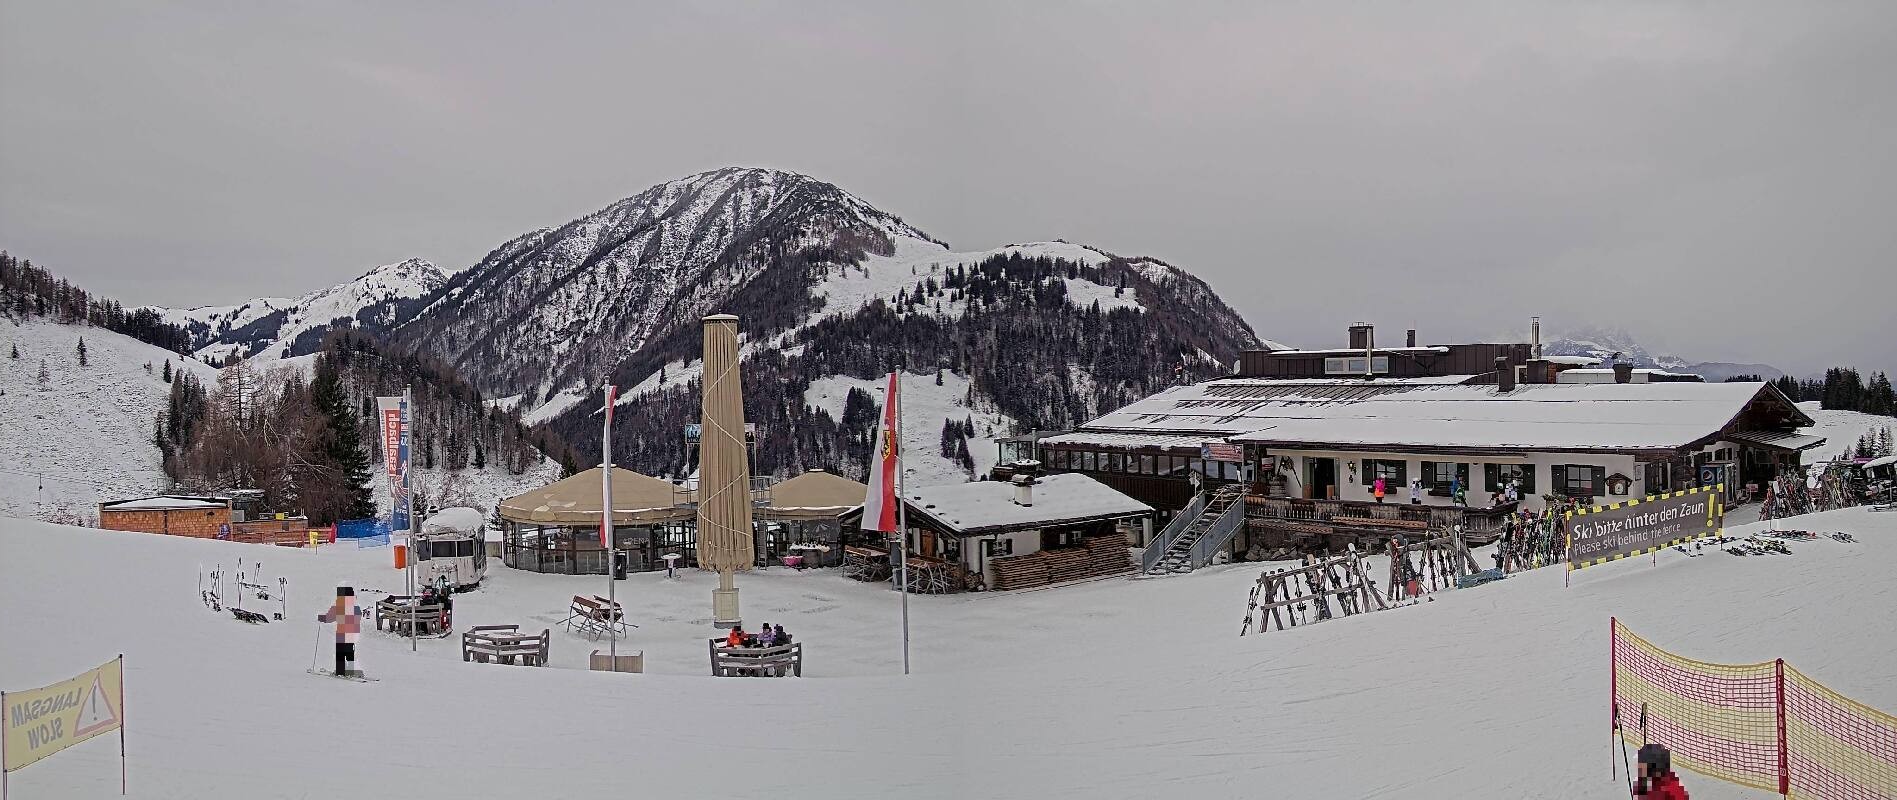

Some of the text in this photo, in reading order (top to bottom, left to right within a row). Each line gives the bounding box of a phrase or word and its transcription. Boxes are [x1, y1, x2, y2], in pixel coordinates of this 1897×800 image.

[1573, 522, 1592, 540] Ski
[1594, 520, 1623, 537] bitte
[1624, 512, 1658, 530] hinter
[1660, 505, 1677, 522] den
[1679, 502, 1704, 518] Zaun
[1574, 541, 1601, 556] Please
[1603, 535, 1616, 550] ski
[1617, 529, 1648, 546] behind
[1651, 526, 1662, 539] the
